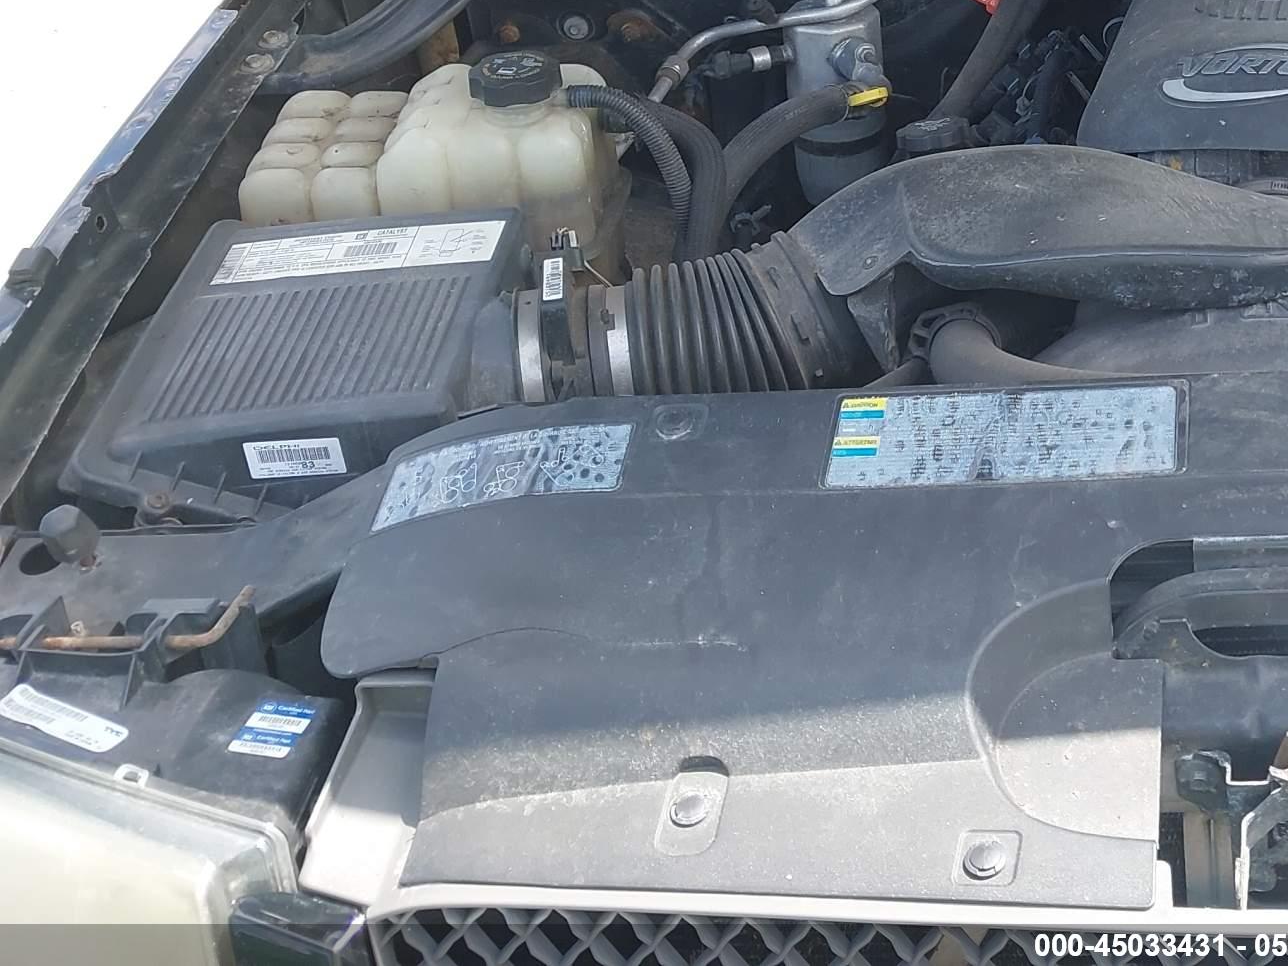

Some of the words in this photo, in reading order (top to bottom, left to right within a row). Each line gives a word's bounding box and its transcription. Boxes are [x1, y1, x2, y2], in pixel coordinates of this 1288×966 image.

[252, 443, 300, 451] DELPHI
[300, 460, 316, 470] 83
[277, 705, 303, 714] Certified
